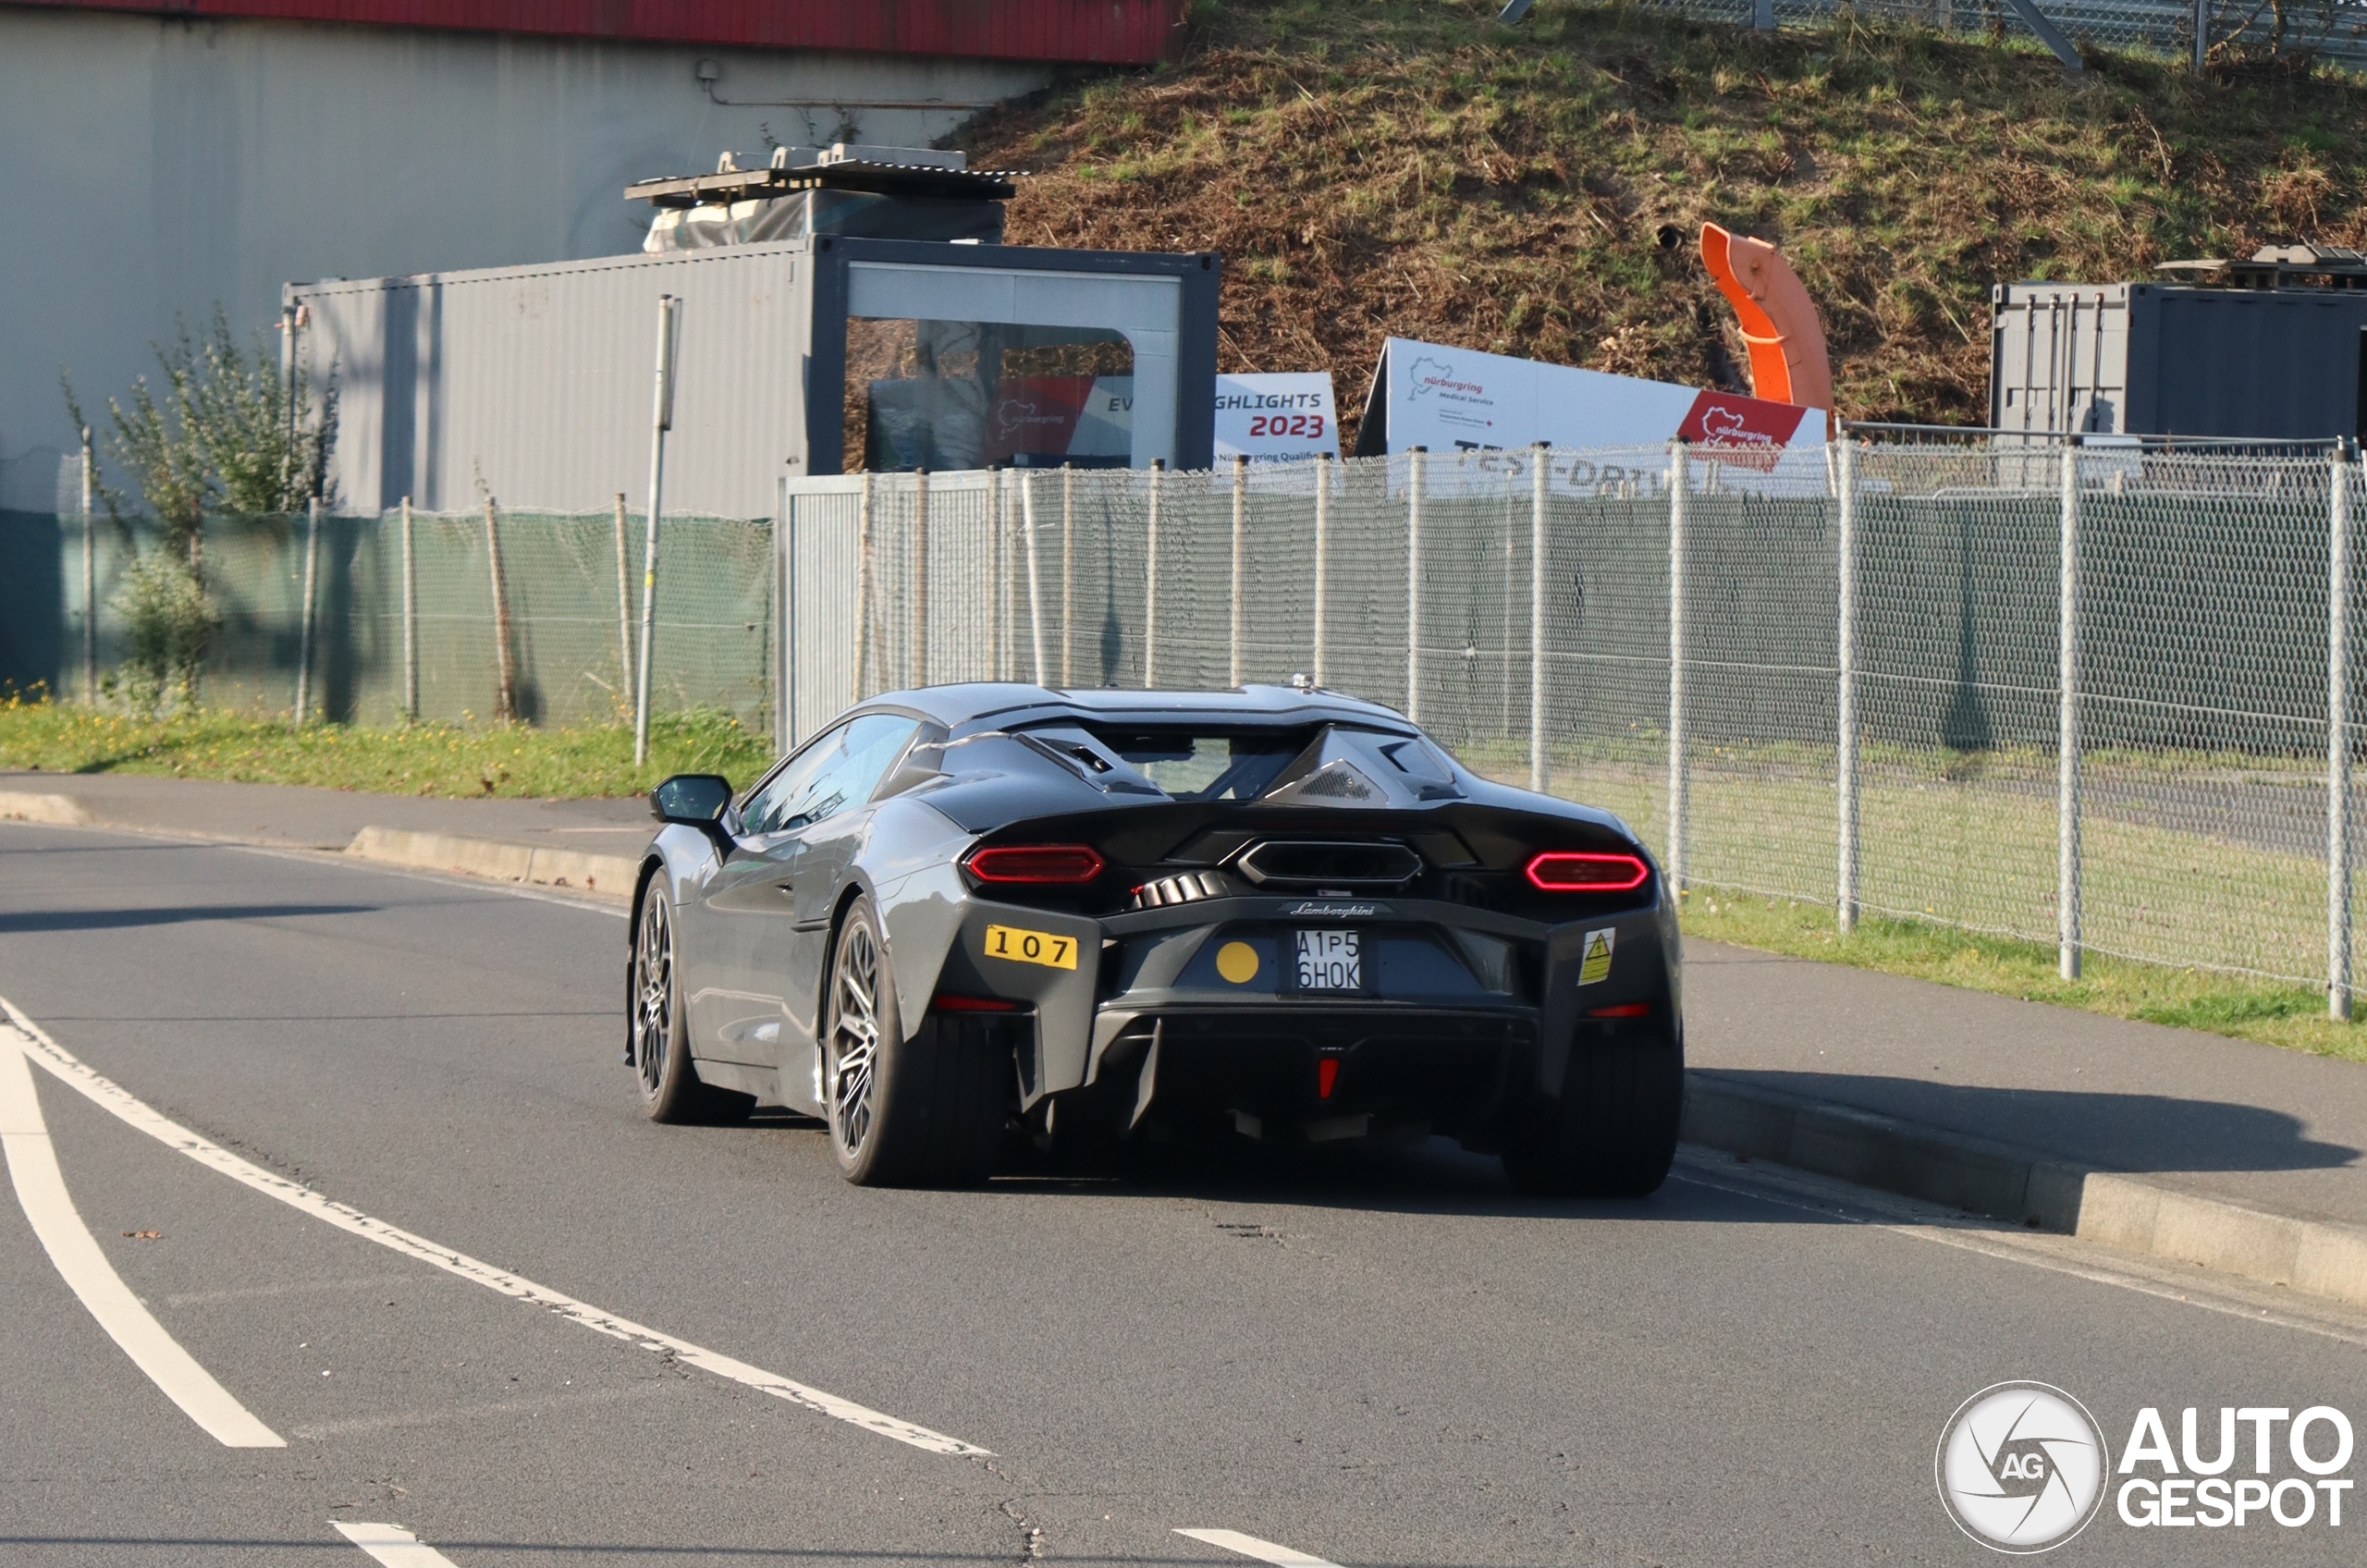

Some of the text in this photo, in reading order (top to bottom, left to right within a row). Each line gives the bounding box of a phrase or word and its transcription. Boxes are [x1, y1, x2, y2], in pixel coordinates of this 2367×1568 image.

[1424, 375, 1483, 395] nürburgring
[1439, 391, 1494, 406] Medical Service
[1250, 414, 1324, 439] 2023
[1715, 425, 1772, 445] nürburgring
[1290, 902, 1375, 918] Lamborghini
[995, 931, 1068, 962] 107
[1298, 931, 1359, 957] A1P5
